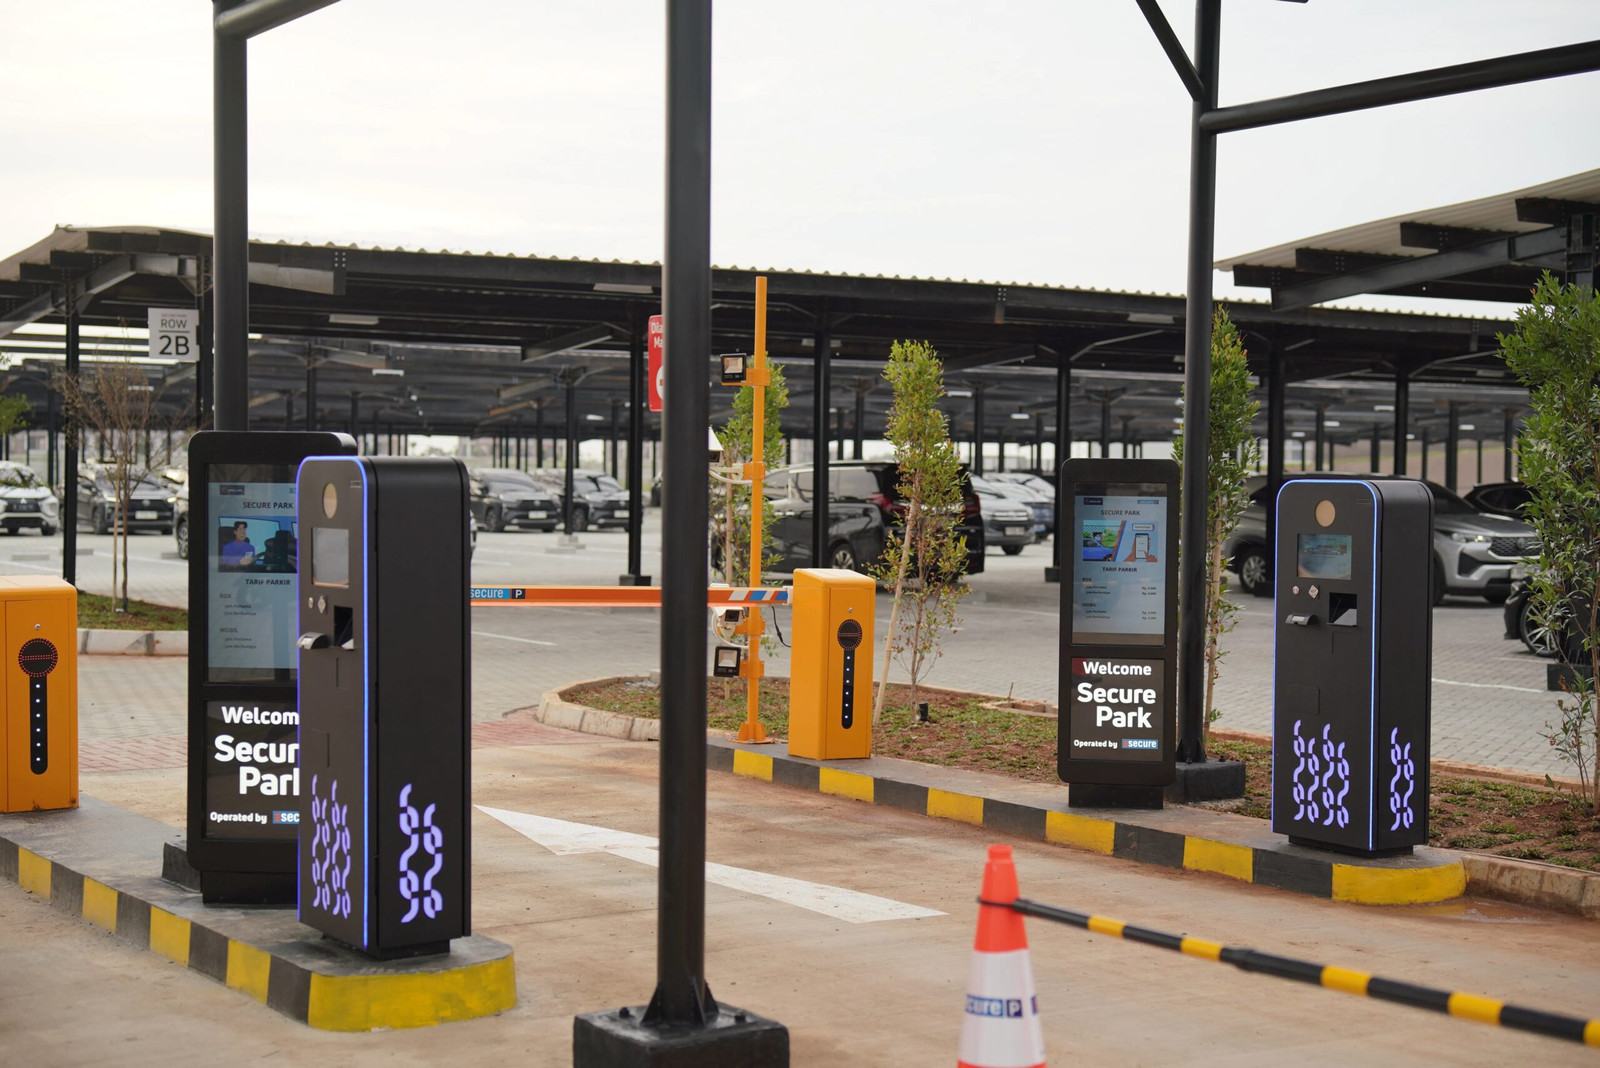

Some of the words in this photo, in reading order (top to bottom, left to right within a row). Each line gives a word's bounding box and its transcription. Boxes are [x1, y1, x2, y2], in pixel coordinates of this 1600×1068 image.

[161, 319, 187, 328] ROW
[651, 322, 664, 334] Dila
[159, 335, 189, 355] 2B
[654, 336, 664, 348] Ma
[242, 501, 271, 509] SECURE
[470, 588, 504, 598] secure
[515, 589, 523, 598] P
[1082, 661, 1152, 676] Welcome
[1077, 682, 1156, 704] Secure
[221, 706, 300, 725] Welcom
[1096, 706, 1152, 728] Park
[214, 734, 300, 763] Secur
[1073, 739, 1107, 748] Operated
[1108, 740, 1118, 749] by
[1128, 740, 1157, 748] secure
[209, 811, 254, 823] Operated
[255, 813, 267, 825] by
[280, 812, 300, 822] sec
[1008, 1000, 1021, 1017] P
